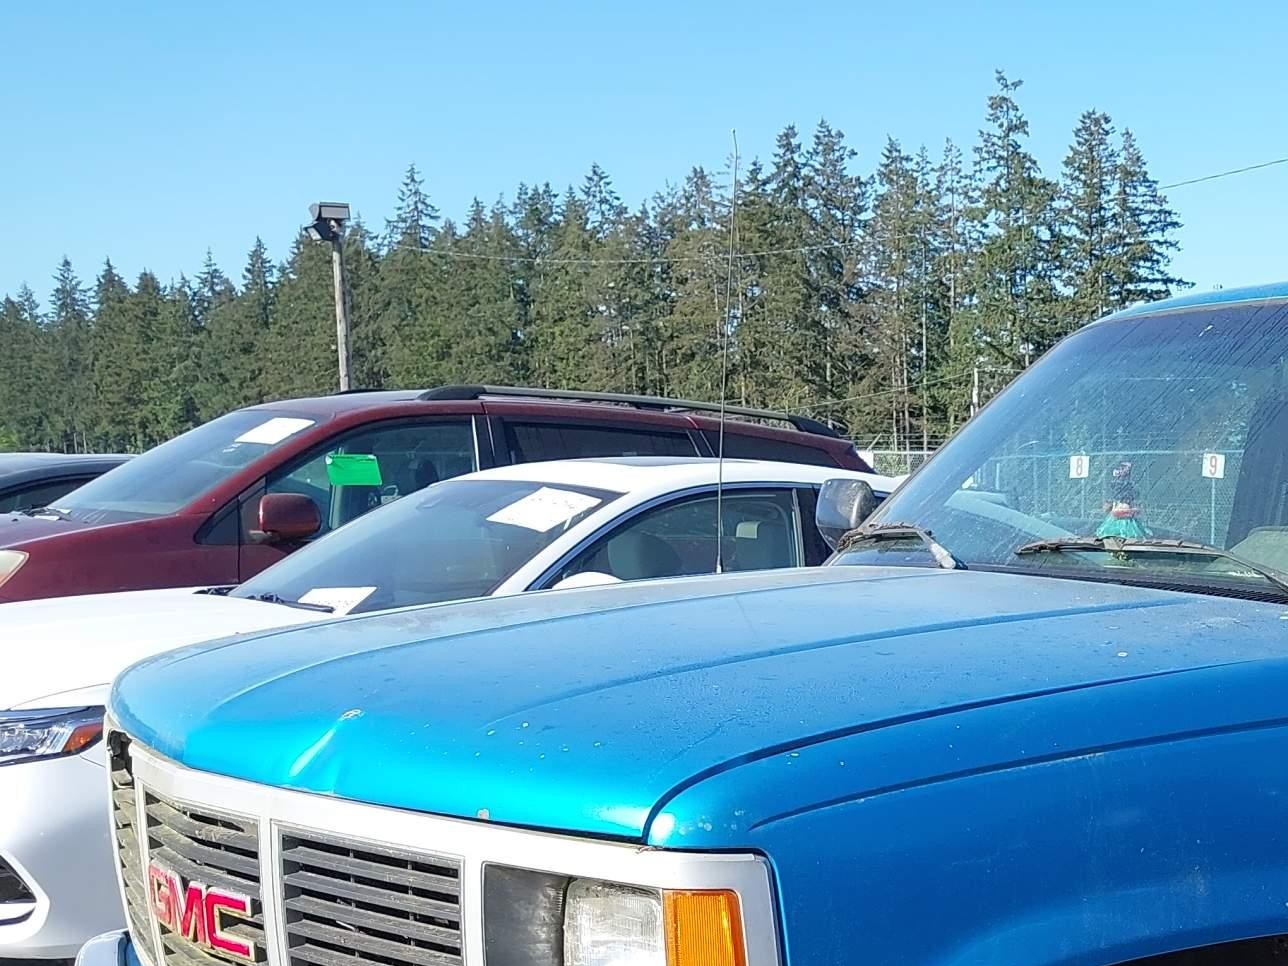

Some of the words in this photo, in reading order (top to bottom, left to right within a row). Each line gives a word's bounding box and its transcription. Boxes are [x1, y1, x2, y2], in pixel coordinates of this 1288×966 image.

[1075, 457, 1084, 477] 8
[1208, 455, 1218, 476] 9
[148, 860, 256, 964] GMC
